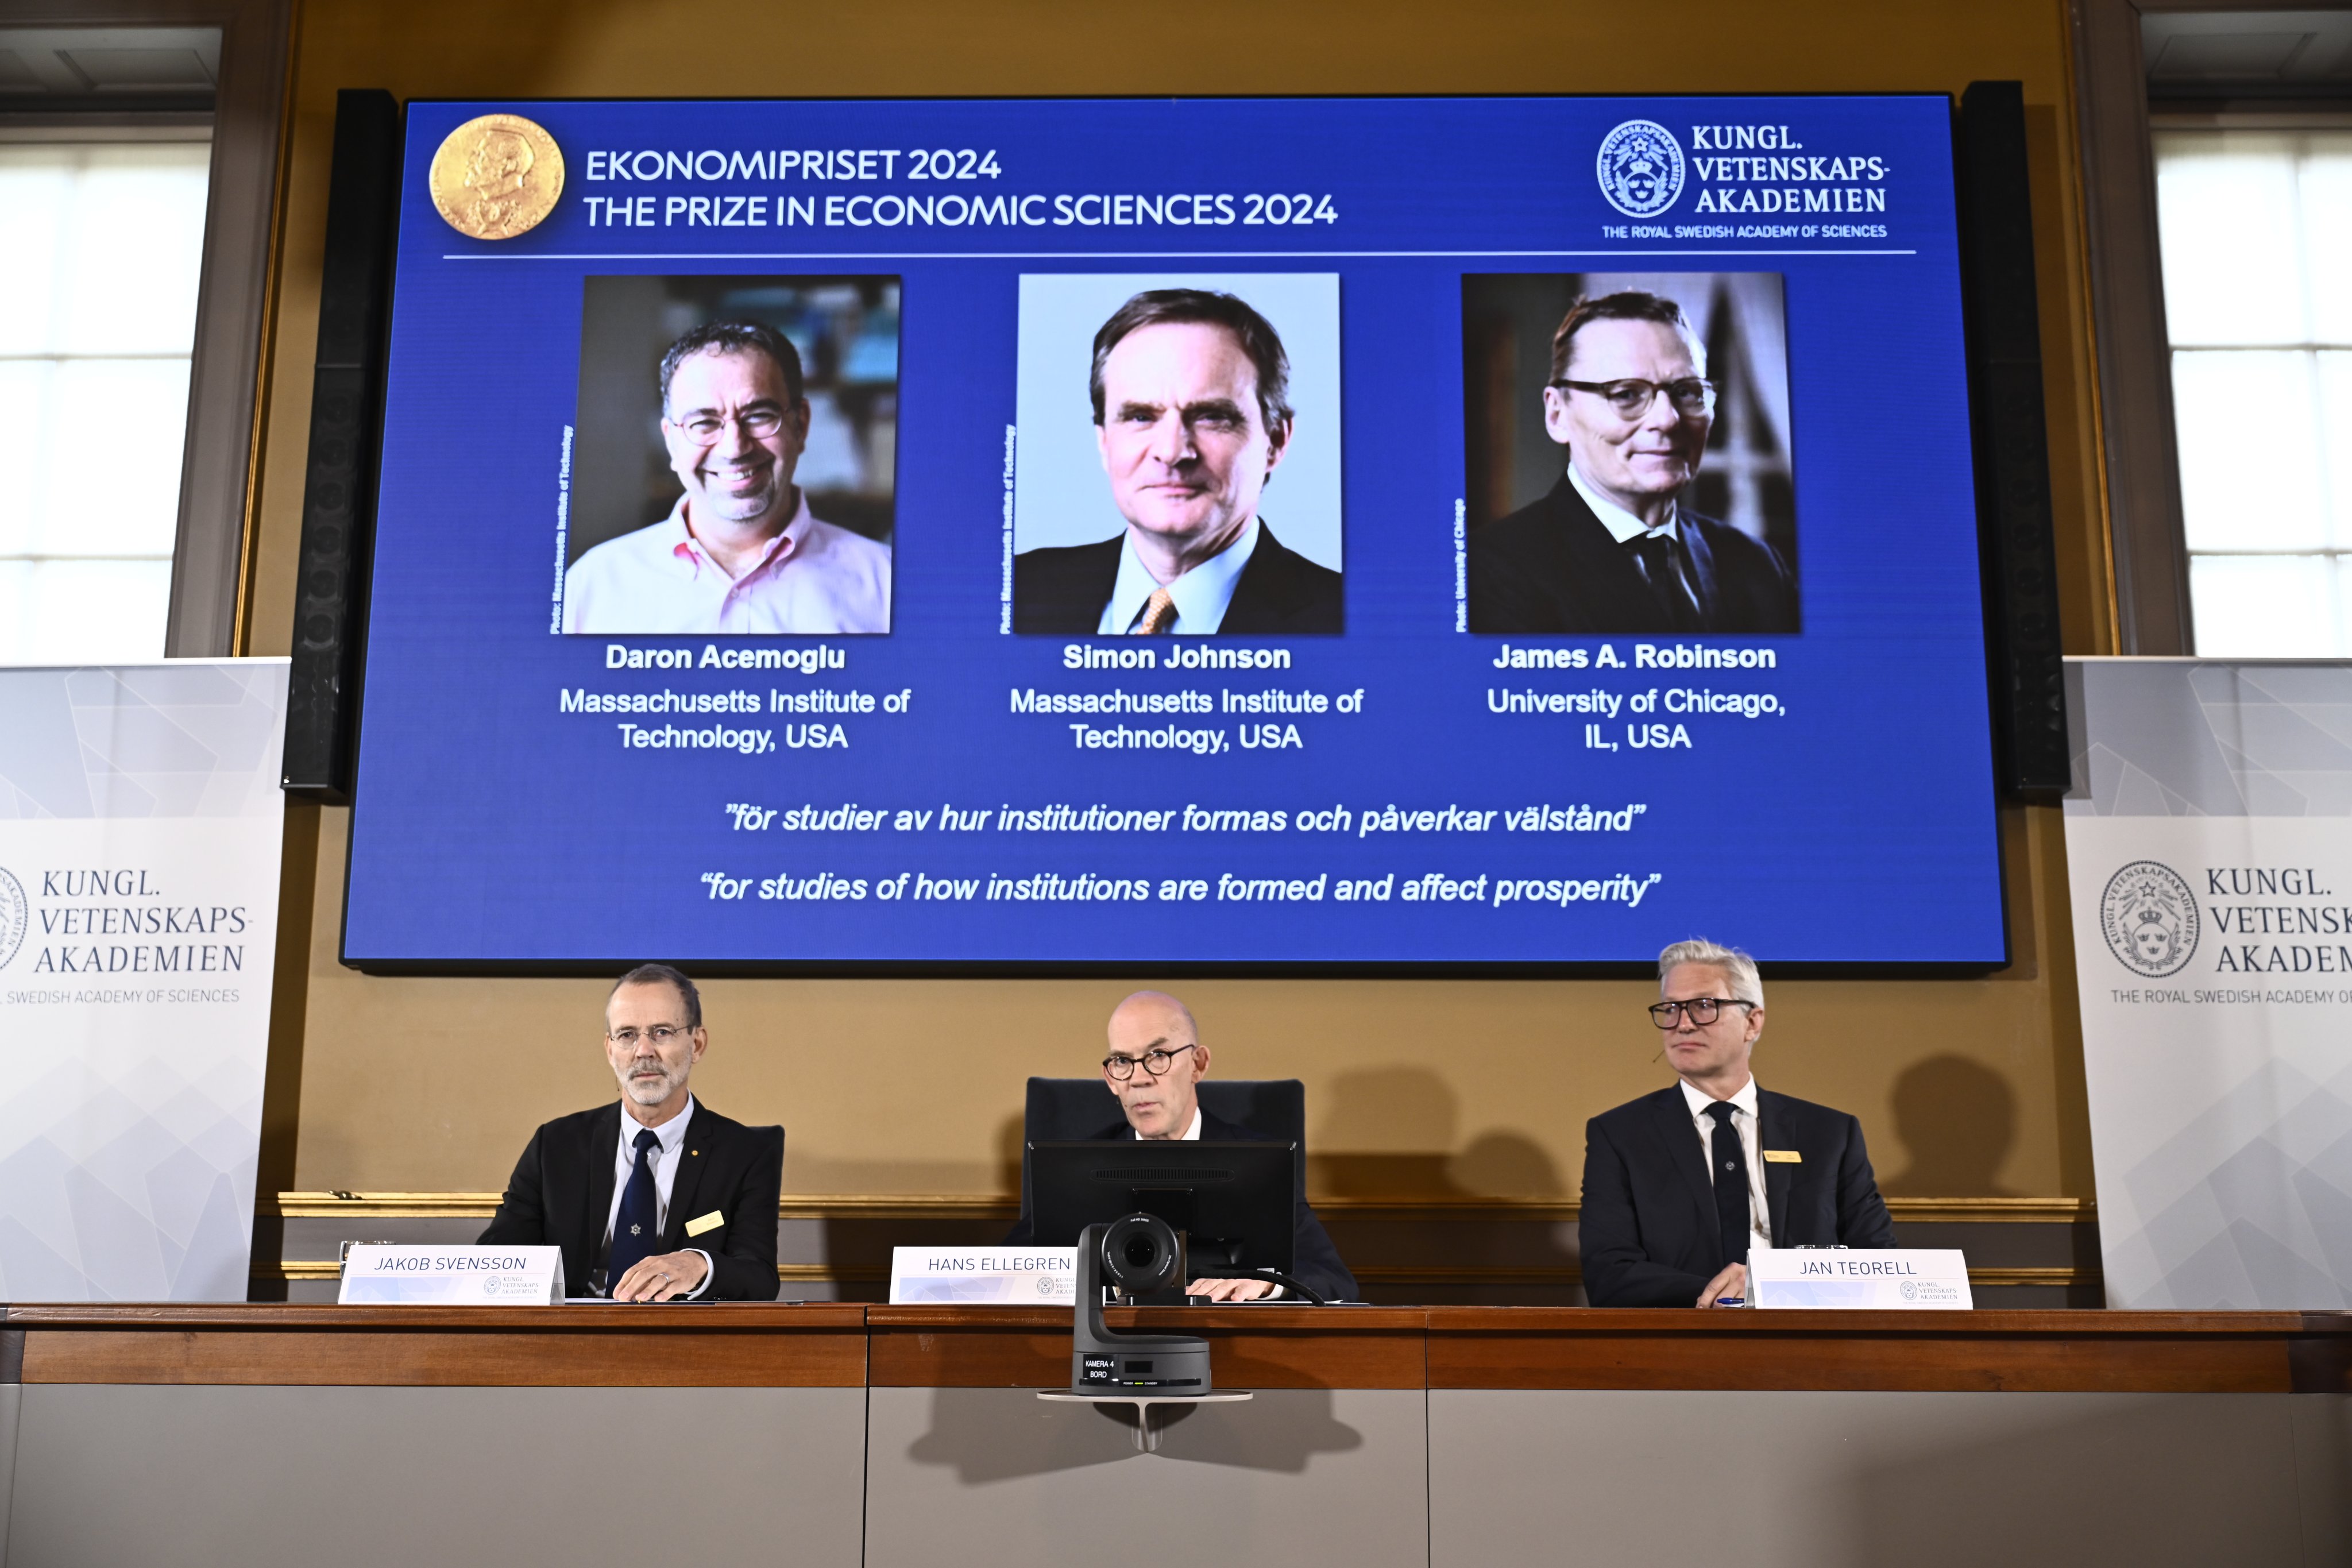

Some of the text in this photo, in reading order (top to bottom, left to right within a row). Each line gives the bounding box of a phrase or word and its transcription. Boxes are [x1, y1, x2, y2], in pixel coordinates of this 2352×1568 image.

[1693, 126, 1802, 149] KUNGL.
[587, 149, 1001, 180] EKONOMIPRISET 2024
[583, 194, 1338, 226] THE PRIZE IN ECONOMIC SCIENCES 2024
[1695, 188, 1885, 213] AKADEMIEN
[1602, 225, 1887, 238] THE ROYAL SWEDISH ACADEMY OF SCIENCES
[607, 644, 845, 674] Daron Acemoglu
[1063, 644, 1290, 668] Simon Johnson
[1493, 644, 1775, 668] James A. Robinson
[561, 689, 912, 713] Massachusetts Institute of
[1011, 689, 1364, 713] Massachusetts Institute of
[1488, 689, 1785, 718] University of Chicago,
[618, 724, 848, 754] Technology, USA
[1069, 724, 1303, 754] Technology, USA
[1586, 724, 1691, 752] IL, USA
[782, 804, 889, 831] studier
[894, 810, 933, 831] av
[939, 804, 992, 831] hur
[998, 804, 1176, 831] institutioner
[1183, 804, 1287, 831] formas
[1296, 804, 1351, 831] och
[1360, 804, 1497, 837] påverkar
[42, 869, 160, 897] KUNGL.
[758, 872, 868, 899] studies
[876, 873, 910, 899] of
[914, 873, 979, 900] how
[986, 873, 1150, 900] institutions
[1158, 880, 1208, 900] are
[1218, 874, 1327, 901] formed
[1335, 874, 1394, 901] and
[1401, 874, 1488, 901] affect
[2206, 867, 2332, 895] KUNGL.
[34, 945, 245, 973] AKADEMIEN
[7, 991, 70, 1004] SWEDISH
[75, 990, 142, 1003] ACADEMY
[147, 990, 164, 1003] OF
[168, 989, 240, 1003] SCIENCES
[2111, 989, 2352, 1004] THE ROYAL SWEDISH ACADEMY O
[374, 1258, 526, 1270] JAKOB SVENSSON
[929, 1258, 1069, 1270] HANS ELLEGREN
[1801, 1262, 1917, 1275] JAN TEORELL
